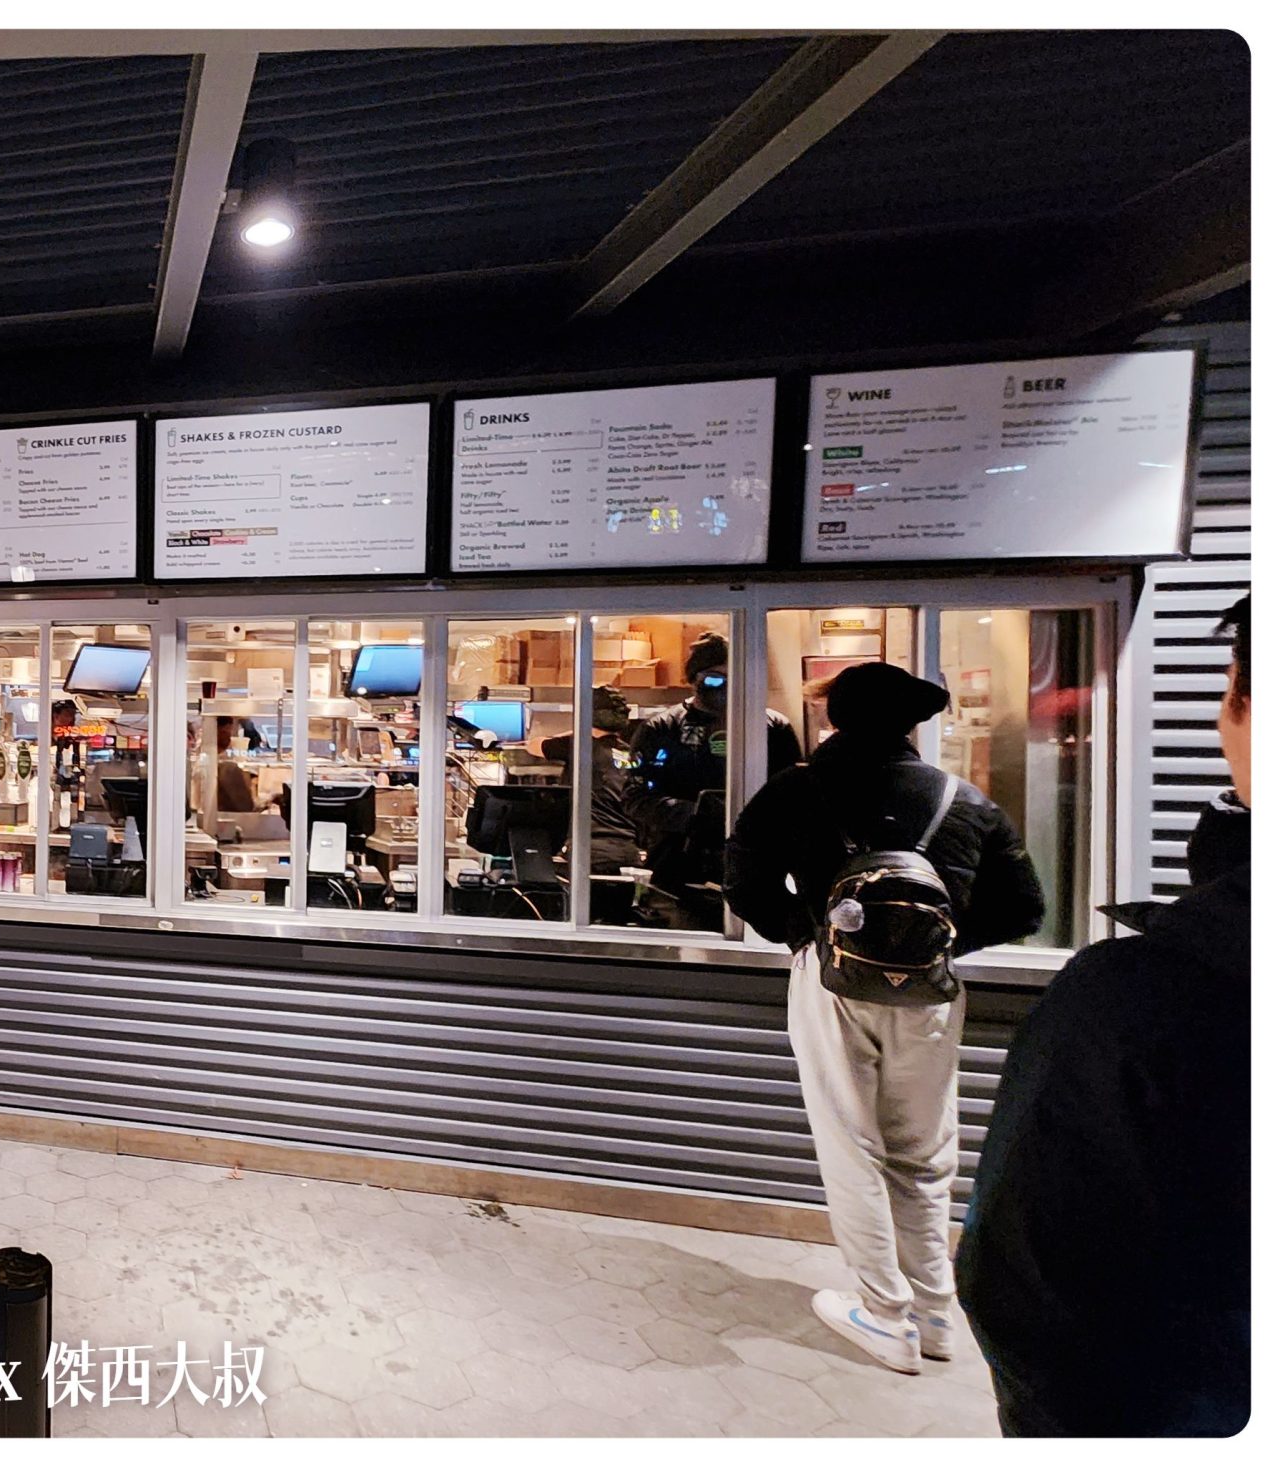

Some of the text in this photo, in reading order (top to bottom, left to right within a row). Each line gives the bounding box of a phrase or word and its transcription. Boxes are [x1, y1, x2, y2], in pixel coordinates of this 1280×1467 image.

[1022, 377, 1067, 392] BEER
[847, 388, 893, 402] WINE
[479, 412, 530, 426] DRINKS
[30, 433, 128, 449] CRINKLE CUT FRIES
[180, 425, 343, 443] SHAKES & FROZEN CUSTARD
